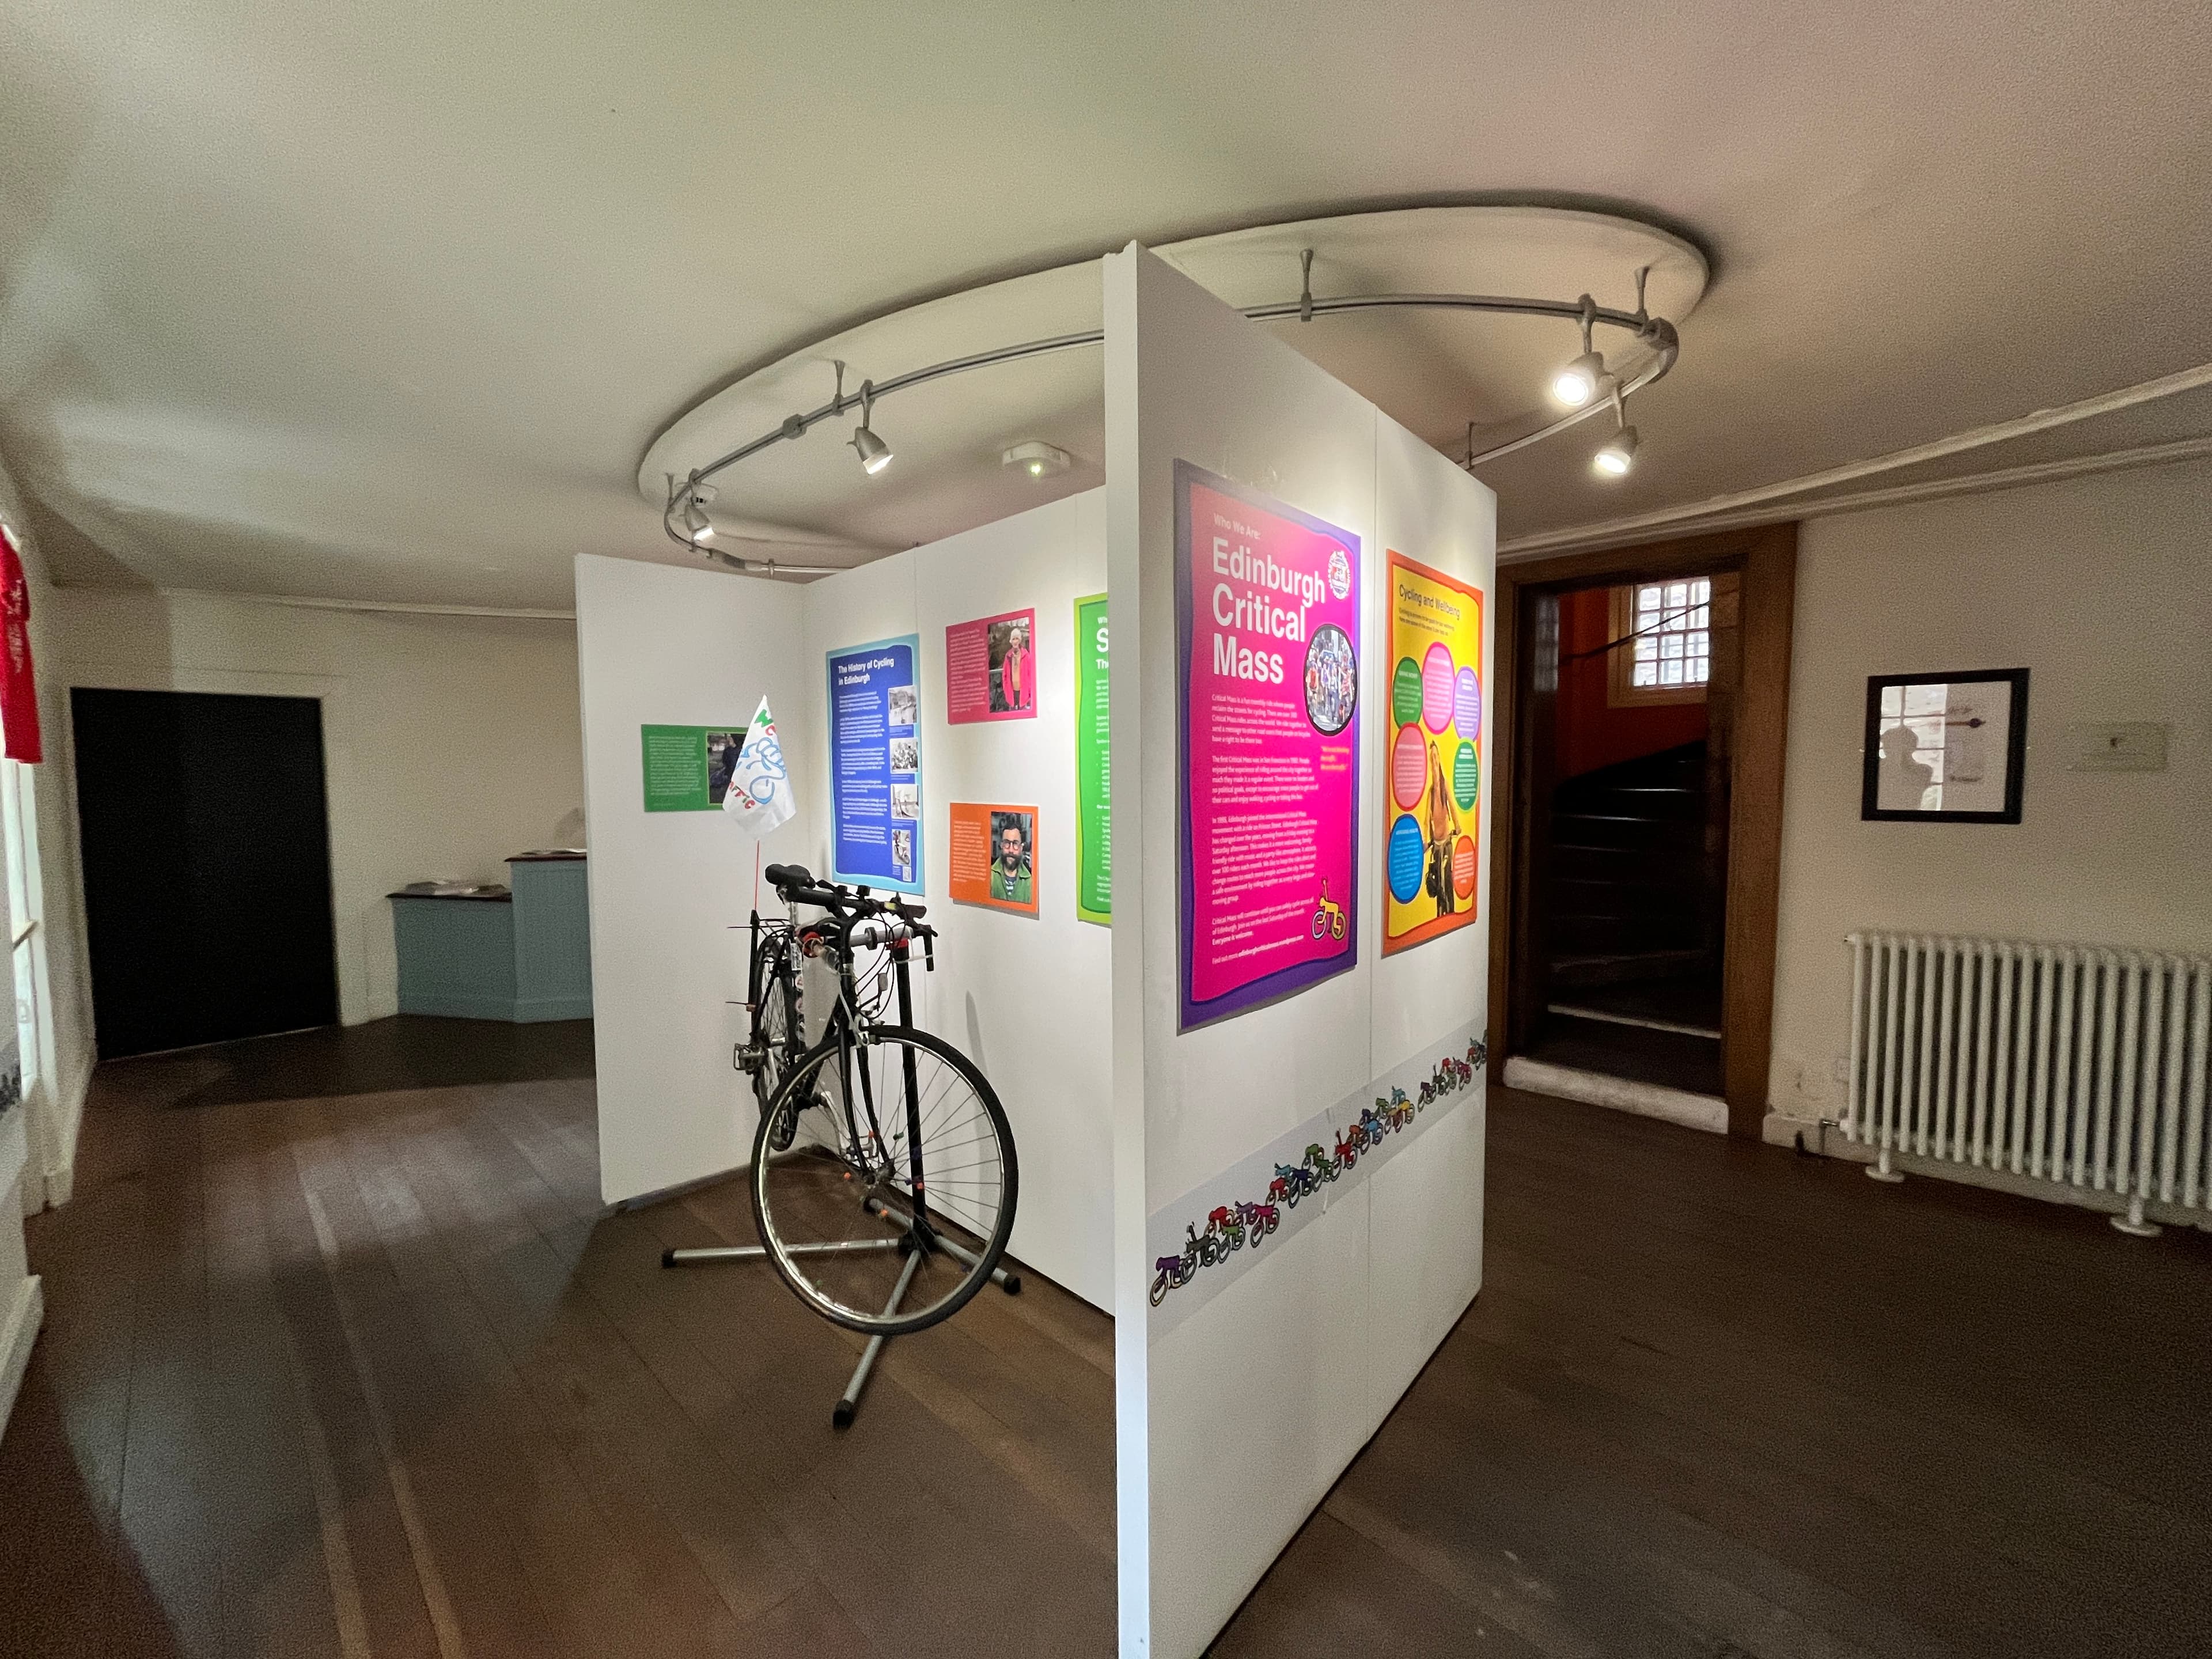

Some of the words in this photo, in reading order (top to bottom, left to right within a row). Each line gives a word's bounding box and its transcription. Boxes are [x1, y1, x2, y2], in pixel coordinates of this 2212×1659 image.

[1213, 513, 1232, 530] Who
[1233, 520, 1245, 535] We
[1245, 524, 1262, 540] Are:
[1213, 536, 1325, 608] Edinburgh
[1213, 582, 1306, 642] Critical
[1399, 584, 1422, 607] Cycling
[1423, 596, 1434, 608] and
[1435, 597, 1460, 620] Wellbeing
[838, 665, 847, 674] The
[848, 663, 866, 672] History
[867, 660, 873, 669] of
[873, 657, 895, 670] Cycling
[1213, 633, 1285, 684] Mass
[844, 673, 870, 684] Edinburgh
